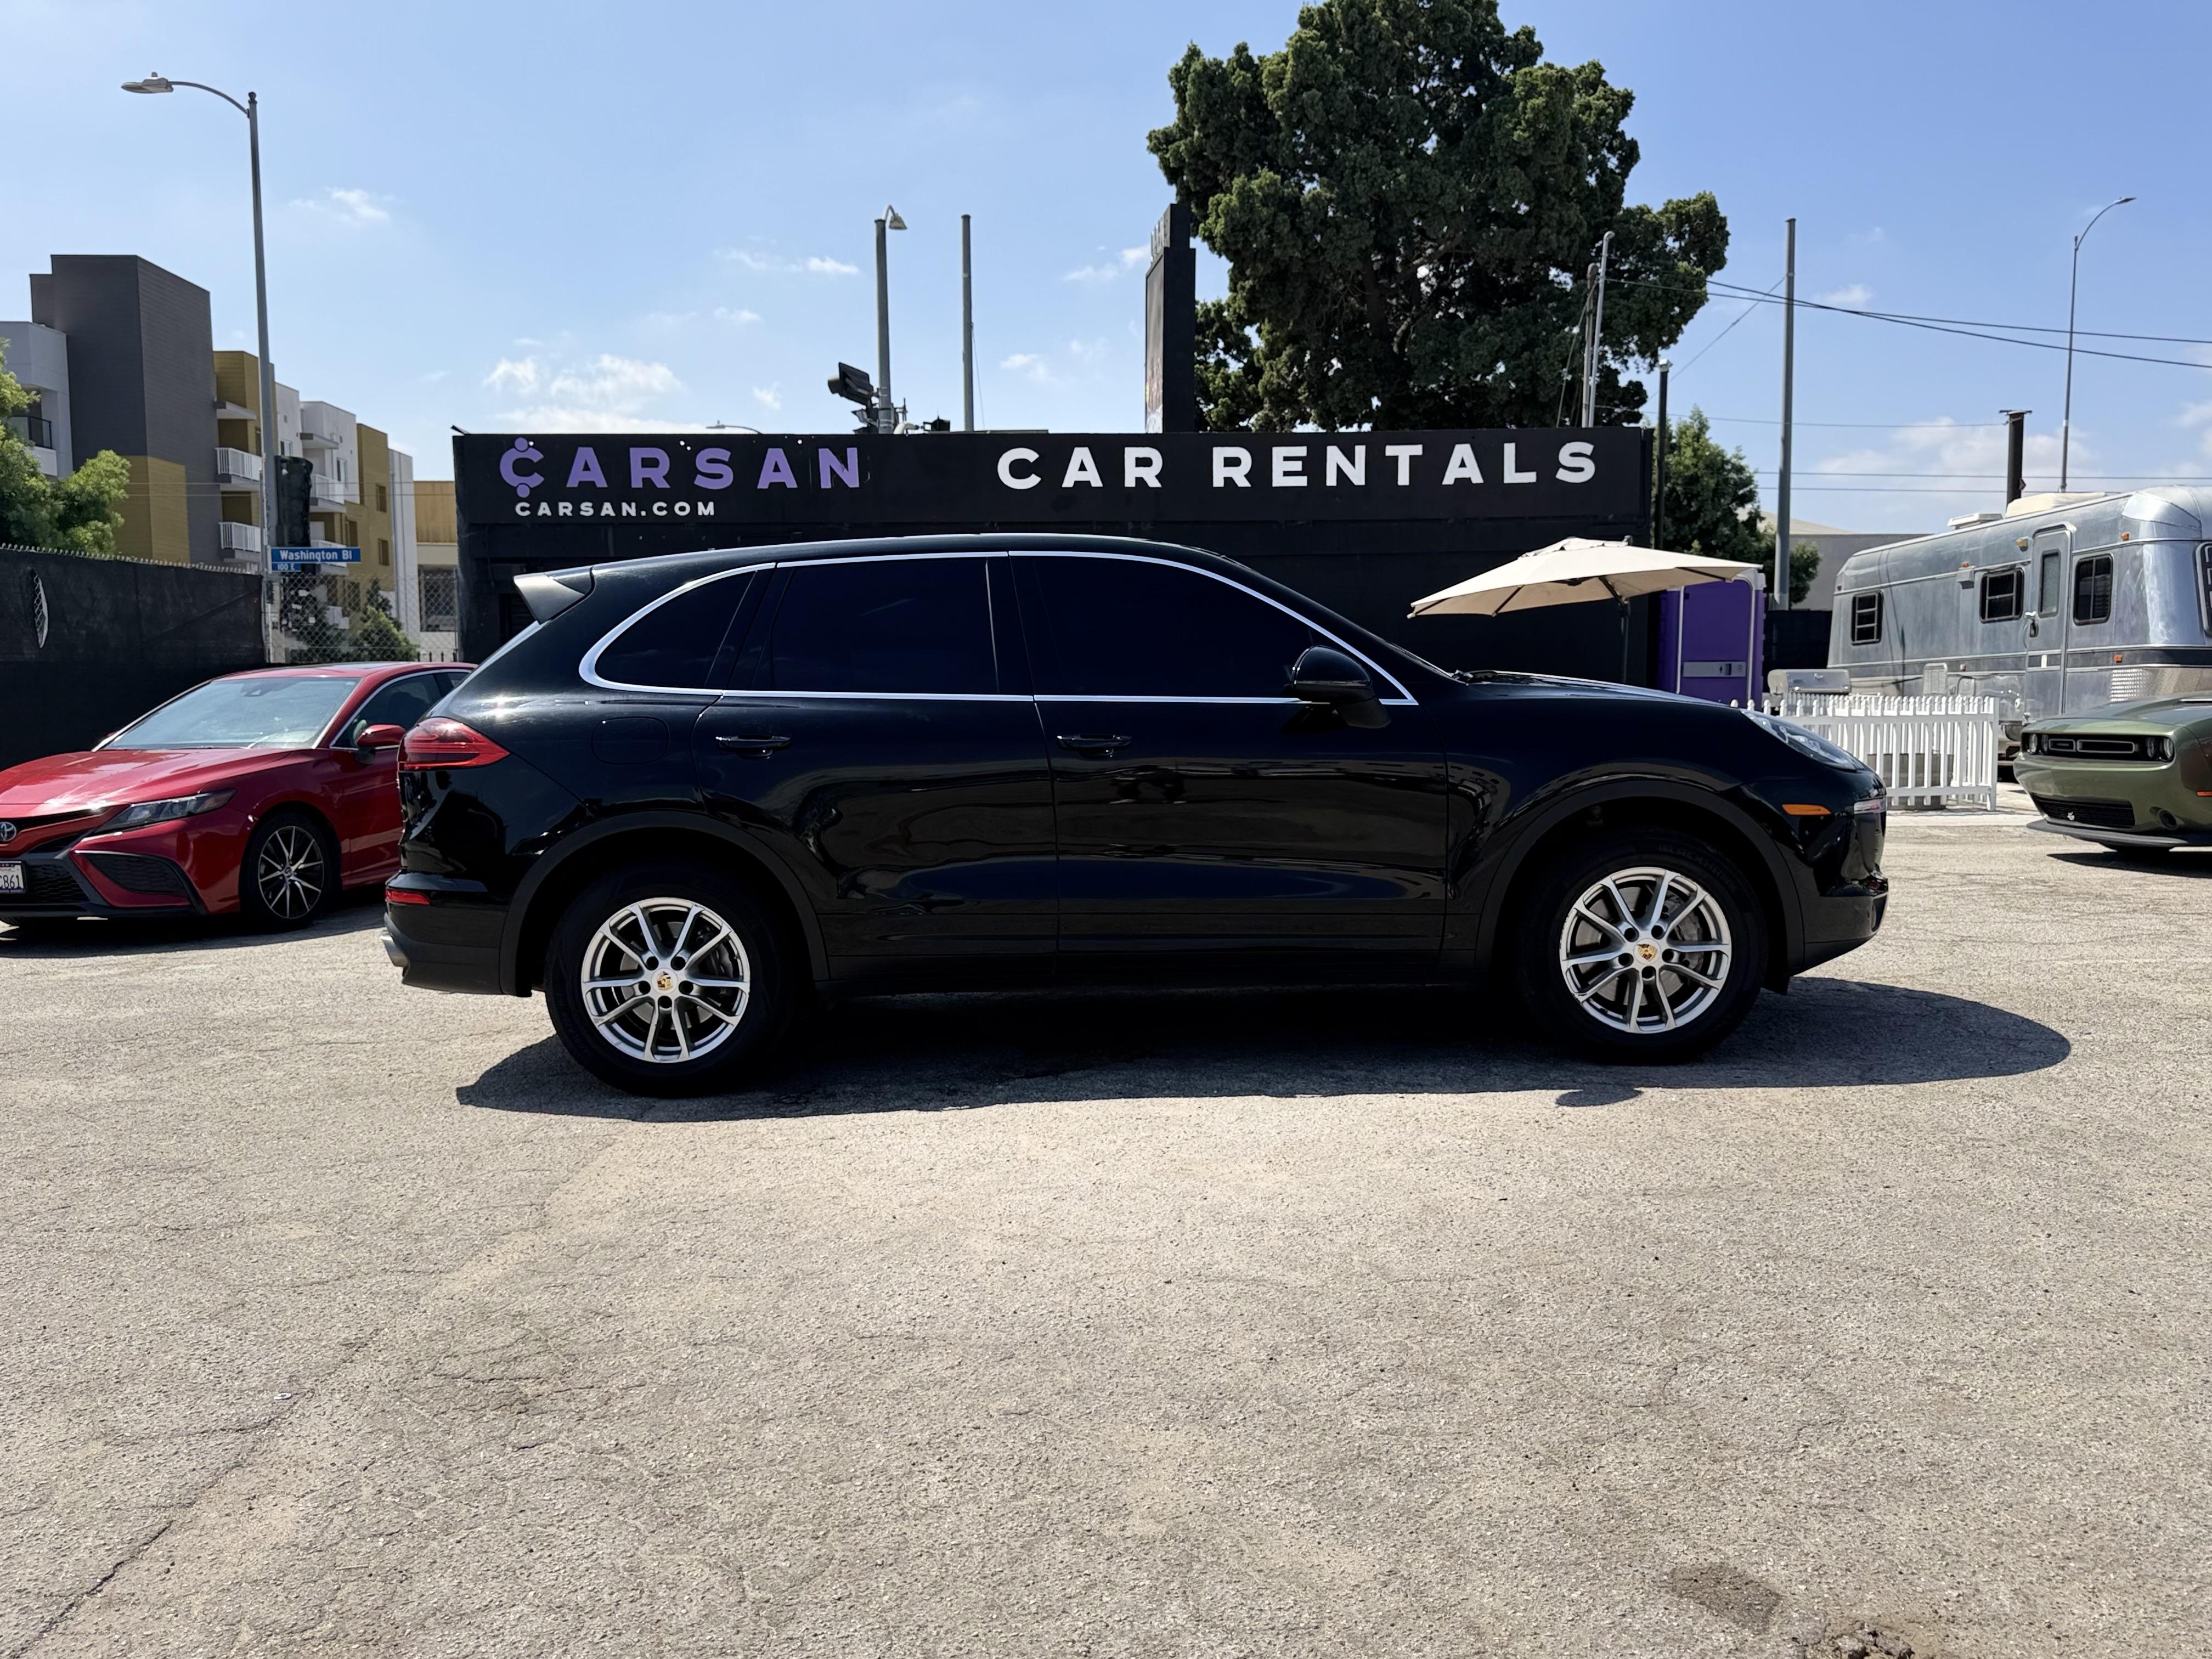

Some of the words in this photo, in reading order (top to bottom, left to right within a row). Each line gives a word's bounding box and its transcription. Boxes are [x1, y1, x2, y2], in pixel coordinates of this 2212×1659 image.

[500, 438, 860, 498] CARSAN
[997, 447, 1163, 490] CAR
[1212, 442, 1595, 488] RENTALS
[515, 501, 715, 517] CARSAN.COM
[280, 550, 338, 562] Washington
[342, 550, 352, 560] Bl
